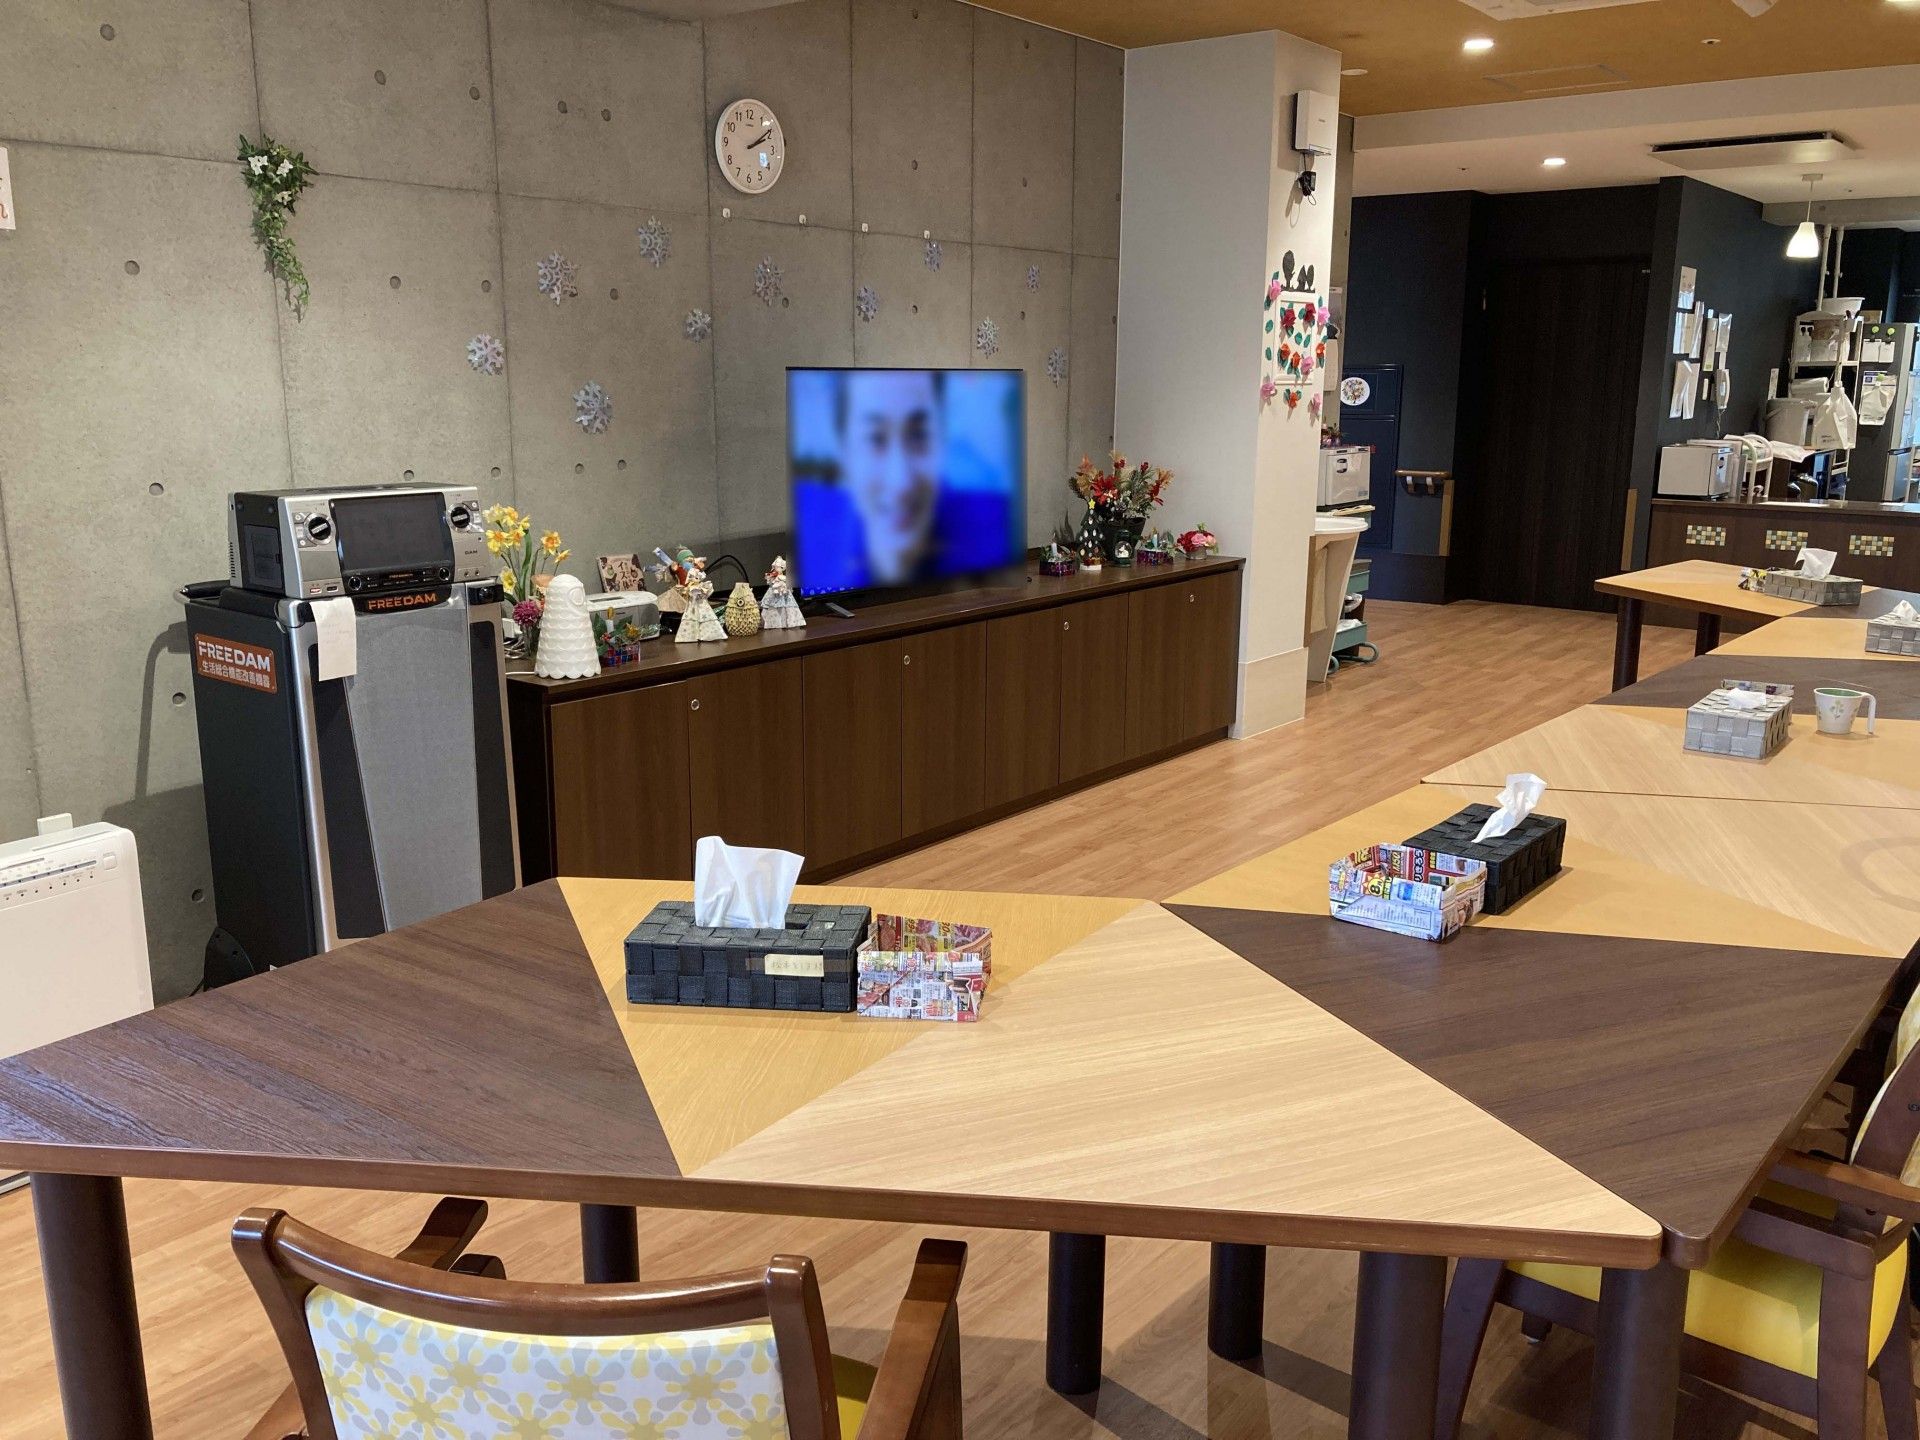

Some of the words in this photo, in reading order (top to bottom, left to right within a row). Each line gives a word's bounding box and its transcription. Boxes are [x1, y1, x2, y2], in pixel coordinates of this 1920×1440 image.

[735, 112, 742, 122] 11
[746, 109, 754, 120] 12
[727, 122, 736, 133] 10
[723, 137, 728, 147] 9
[771, 145, 775, 156] 3
[728, 155, 733, 165] 8
[736, 167, 741, 177] 7
[758, 171, 763, 181] 5
[747, 174, 752, 183] 6
[368, 593, 437, 611] FREEDAM
[198, 640, 271, 672] FREEDAM
